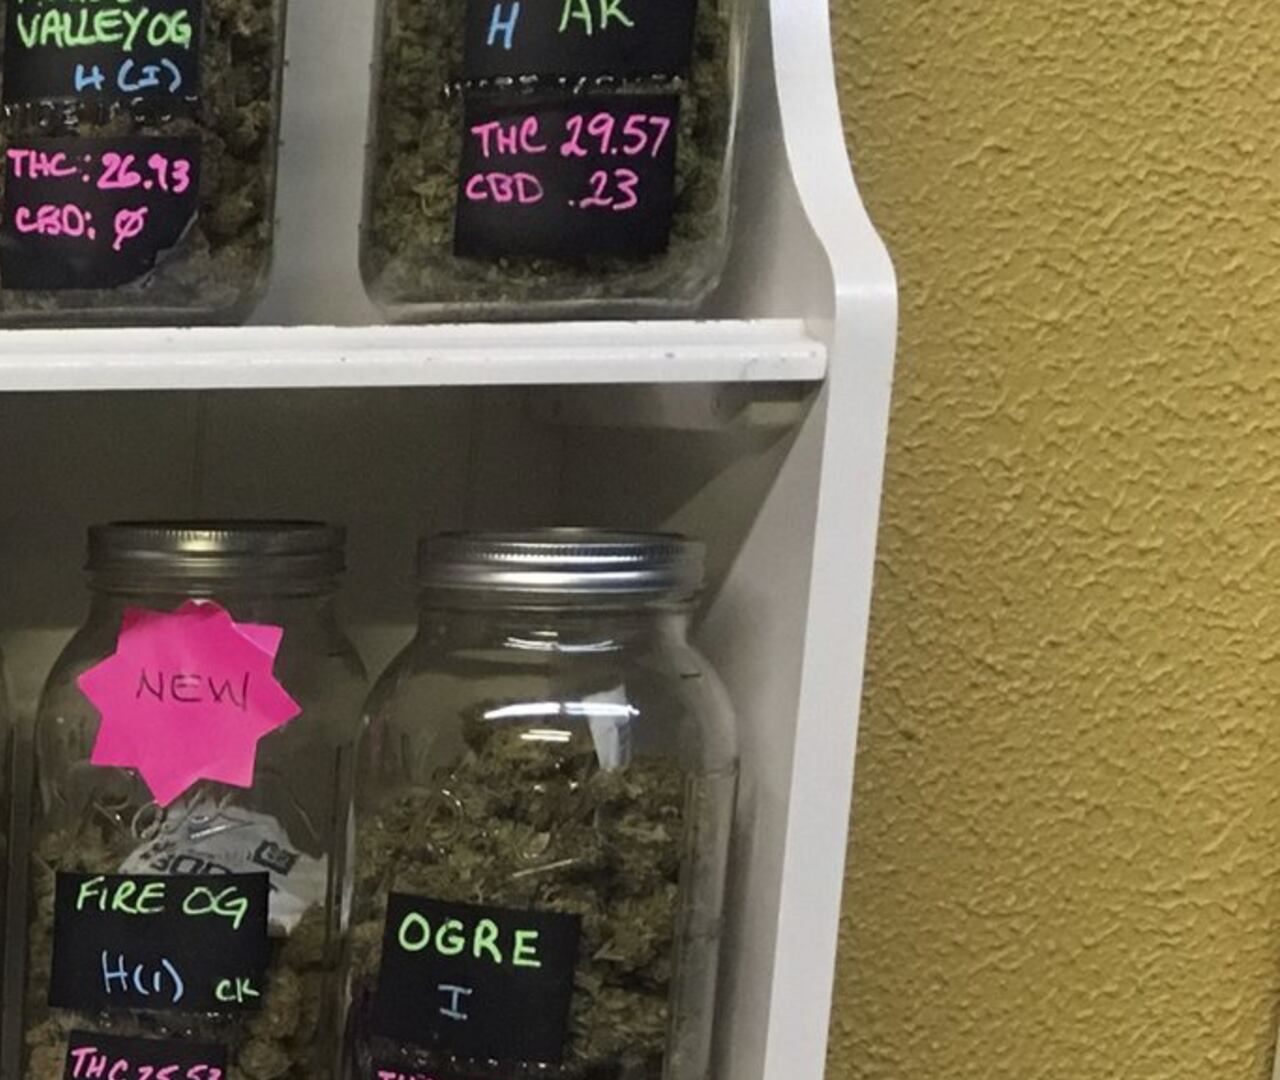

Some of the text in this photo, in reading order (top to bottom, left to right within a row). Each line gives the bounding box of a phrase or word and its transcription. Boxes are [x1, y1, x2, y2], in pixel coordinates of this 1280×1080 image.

[17, 7, 192, 51] VALLEY OG
[486, 1, 520, 50] H
[471, 112, 671, 158] THC 29.57
[96, 152, 191, 194] 26.93
[464, 168, 639, 210] CBD .23
[136, 670, 250, 710] NEW
[75, 875, 248, 930] FIRE OG
[398, 912, 542, 967] OGRE
[438, 983, 473, 1020] I
